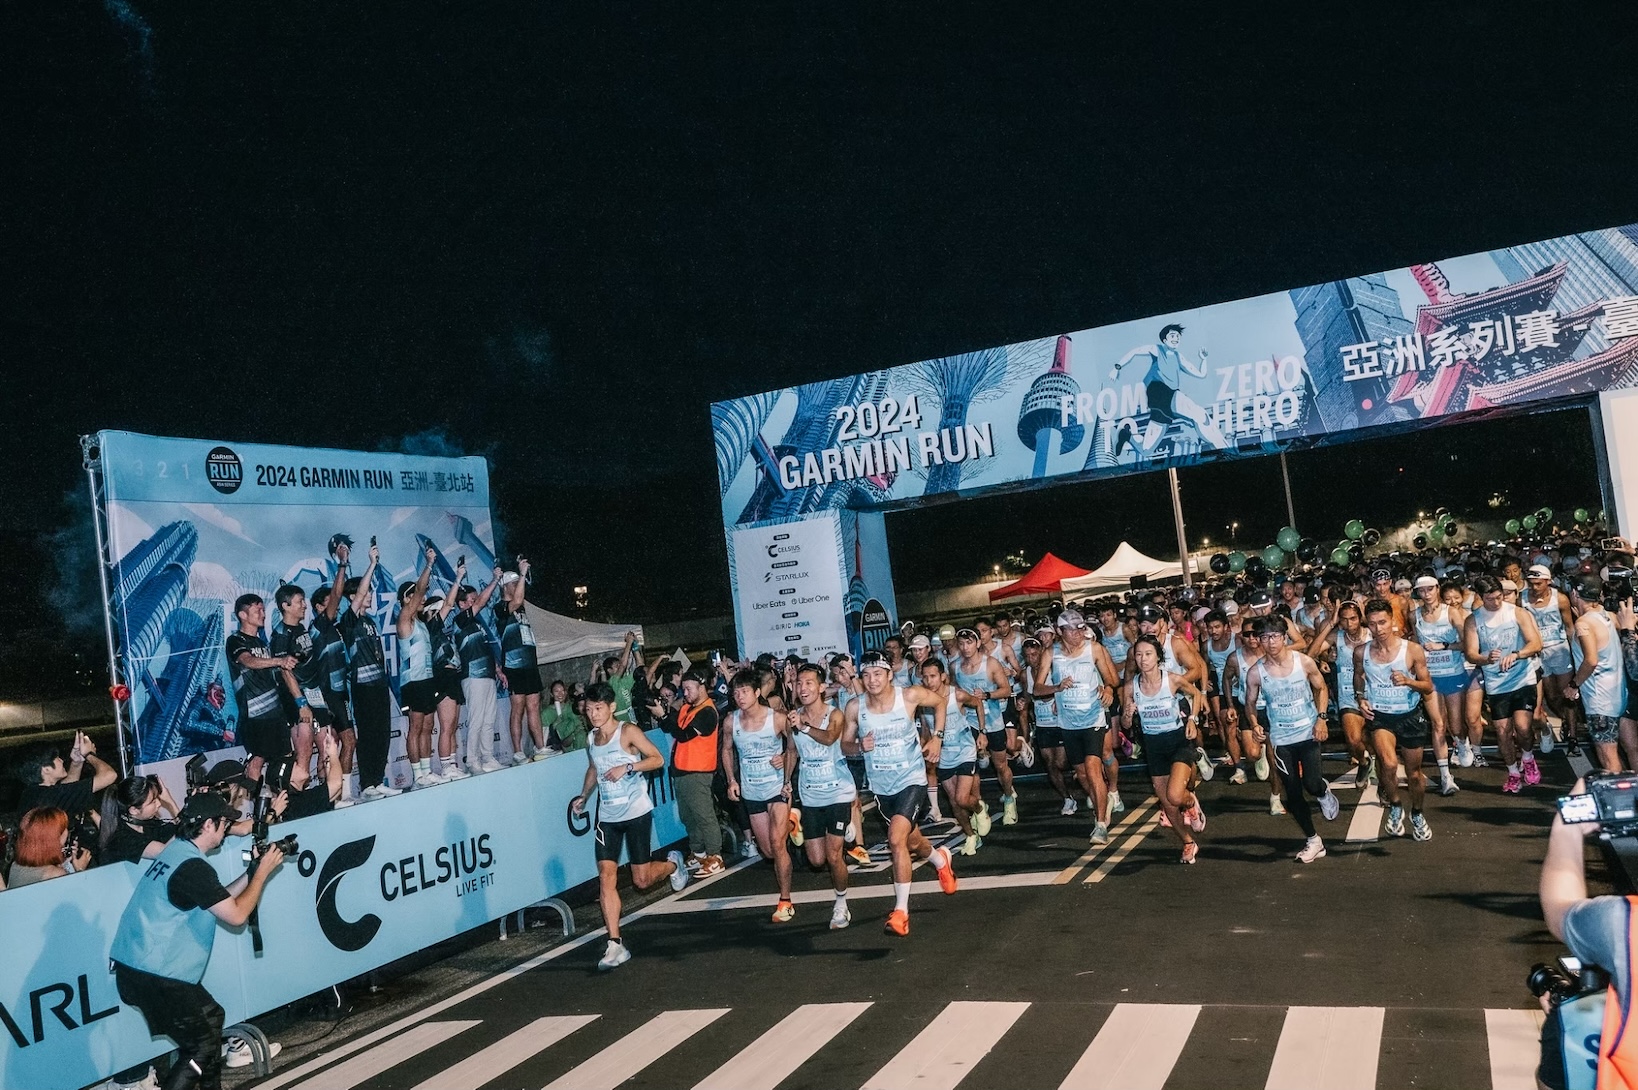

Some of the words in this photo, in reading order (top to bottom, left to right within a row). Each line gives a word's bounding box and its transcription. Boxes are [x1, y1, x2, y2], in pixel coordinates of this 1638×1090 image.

[1340, 310, 1560, 382] 亞洲系列賽
[1061, 381, 1148, 428] FROM
[1215, 354, 1301, 400] ZERO
[1213, 390, 1300, 433] HERO
[836, 394, 922, 442] 2024
[779, 437, 912, 490] GARMIN
[918, 422, 995, 467] RUN
[209, 463, 240, 479] RUN
[255, 464, 297, 487] 2024
[300, 466, 361, 489] GARMIN
[363, 469, 394, 490] RUN
[400, 470, 474, 493] 亞洲-臺北站
[778, 544, 801, 553] CELSIUS
[775, 571, 810, 582] STARLUX
[753, 602, 769, 610] Uber
[769, 600, 786, 608] Eats
[798, 597, 815, 605] Uber
[865, 612, 886, 622] GARMIN
[1426, 655, 1451, 664] 22648
[1063, 690, 1088, 698] 20126
[1375, 689, 1404, 698] 20006
[1142, 709, 1170, 718] 22056
[1276, 706, 1303, 716] 20001
[873, 747, 902, 757] 21842
[806, 767, 833, 777] 21840
[380, 834, 494, 902] CELSIUS
[456, 879, 478, 898] LIVE
[480, 872, 495, 890] FIT
